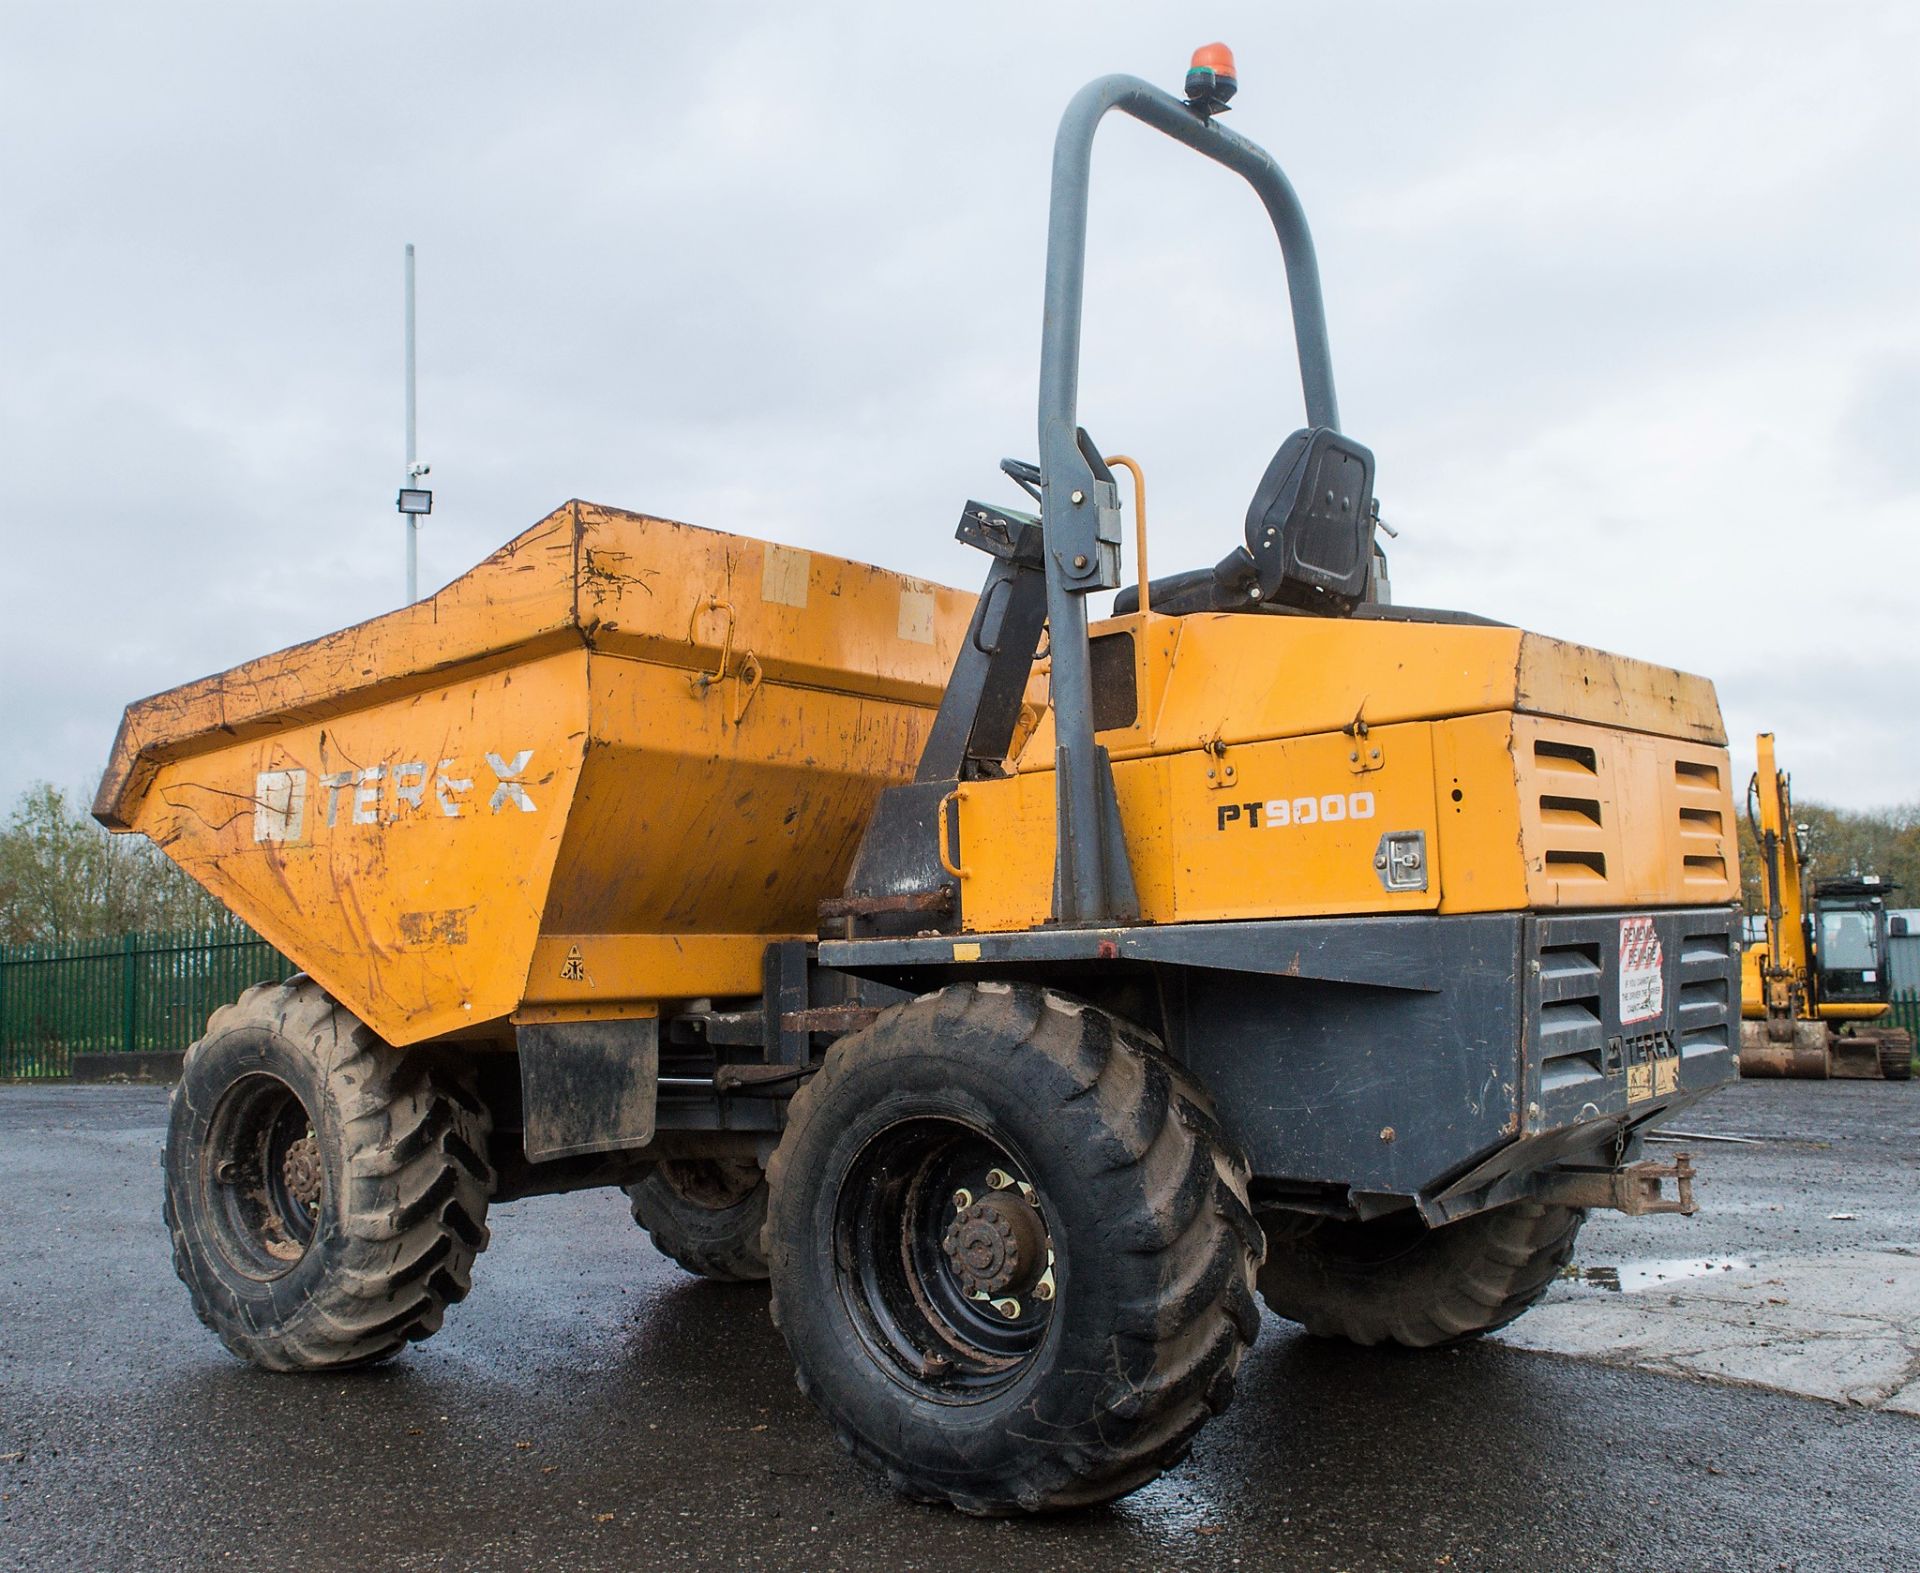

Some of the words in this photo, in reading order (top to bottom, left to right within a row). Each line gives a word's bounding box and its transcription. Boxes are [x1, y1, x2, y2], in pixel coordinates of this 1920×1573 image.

[319, 750, 538, 828] TEREX
[1217, 792, 1375, 831] PT9000
[1625, 1029, 1678, 1065] TEREX
